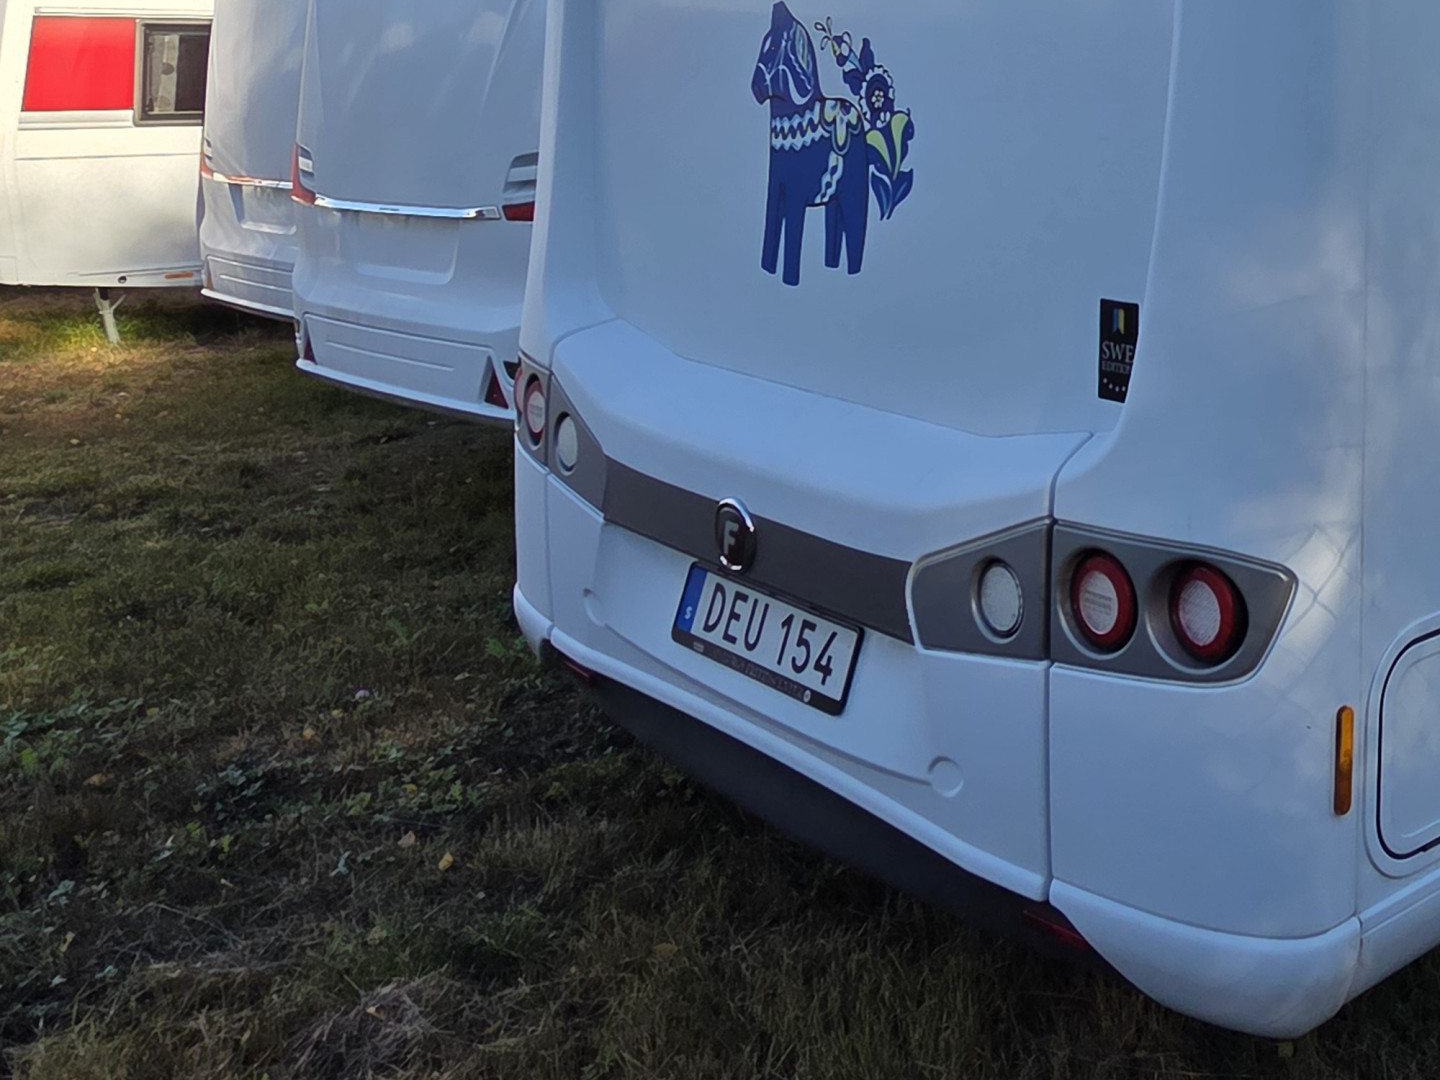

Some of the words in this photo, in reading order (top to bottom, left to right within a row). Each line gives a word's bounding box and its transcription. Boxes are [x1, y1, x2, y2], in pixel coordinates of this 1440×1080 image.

[1102, 341, 1134, 363] SWE
[722, 520, 739, 555] F
[684, 606, 693, 620] S
[702, 582, 770, 652] DEU
[776, 613, 838, 686] 154
